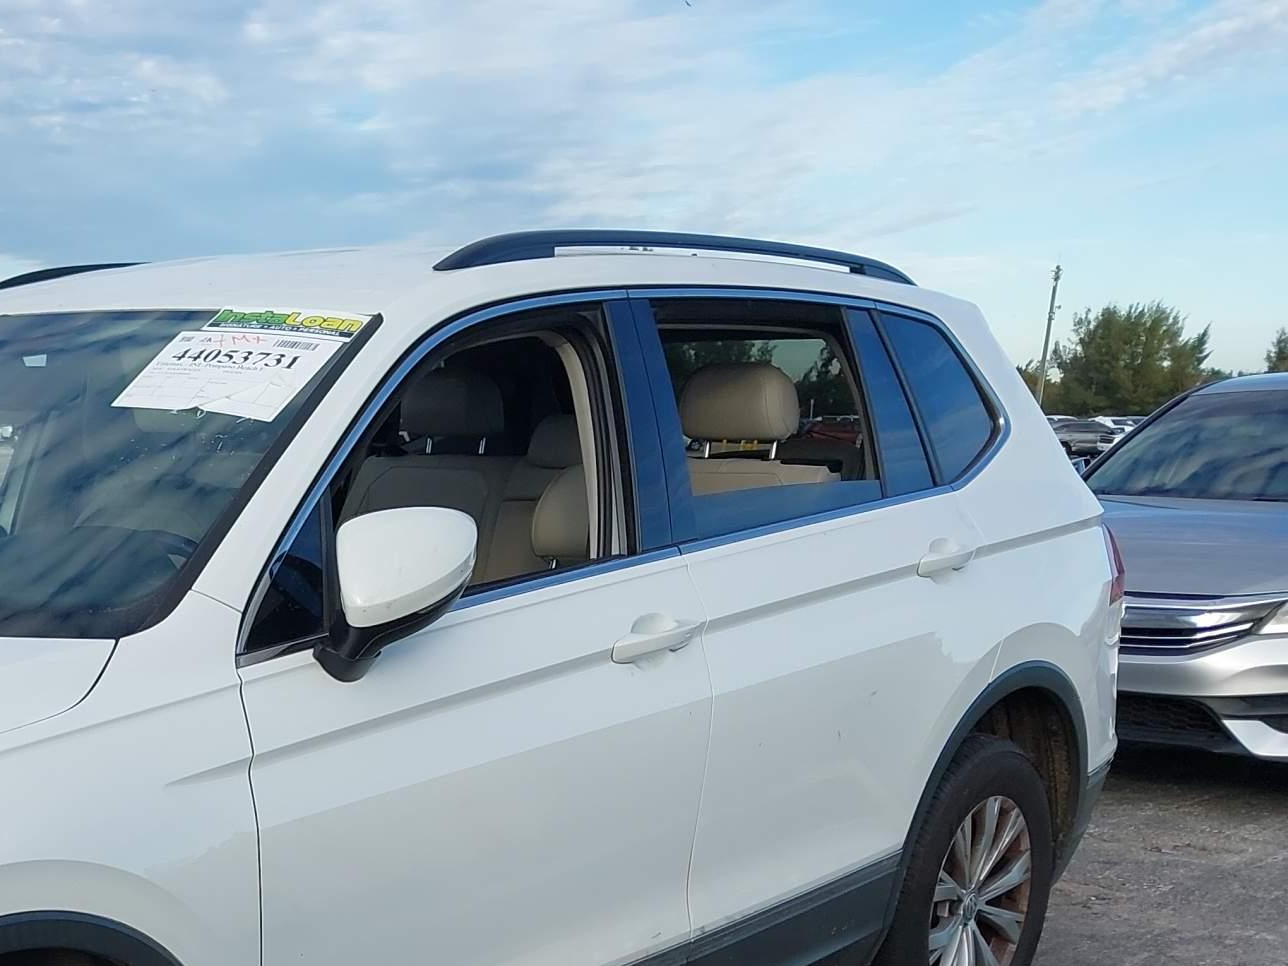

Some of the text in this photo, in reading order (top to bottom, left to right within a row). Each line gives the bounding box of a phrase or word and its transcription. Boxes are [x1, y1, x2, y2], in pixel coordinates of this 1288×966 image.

[214, 309, 362, 331] InstaLoan
[297, 327, 340, 336] PERSONAL
[171, 348, 302, 369] 44053731
